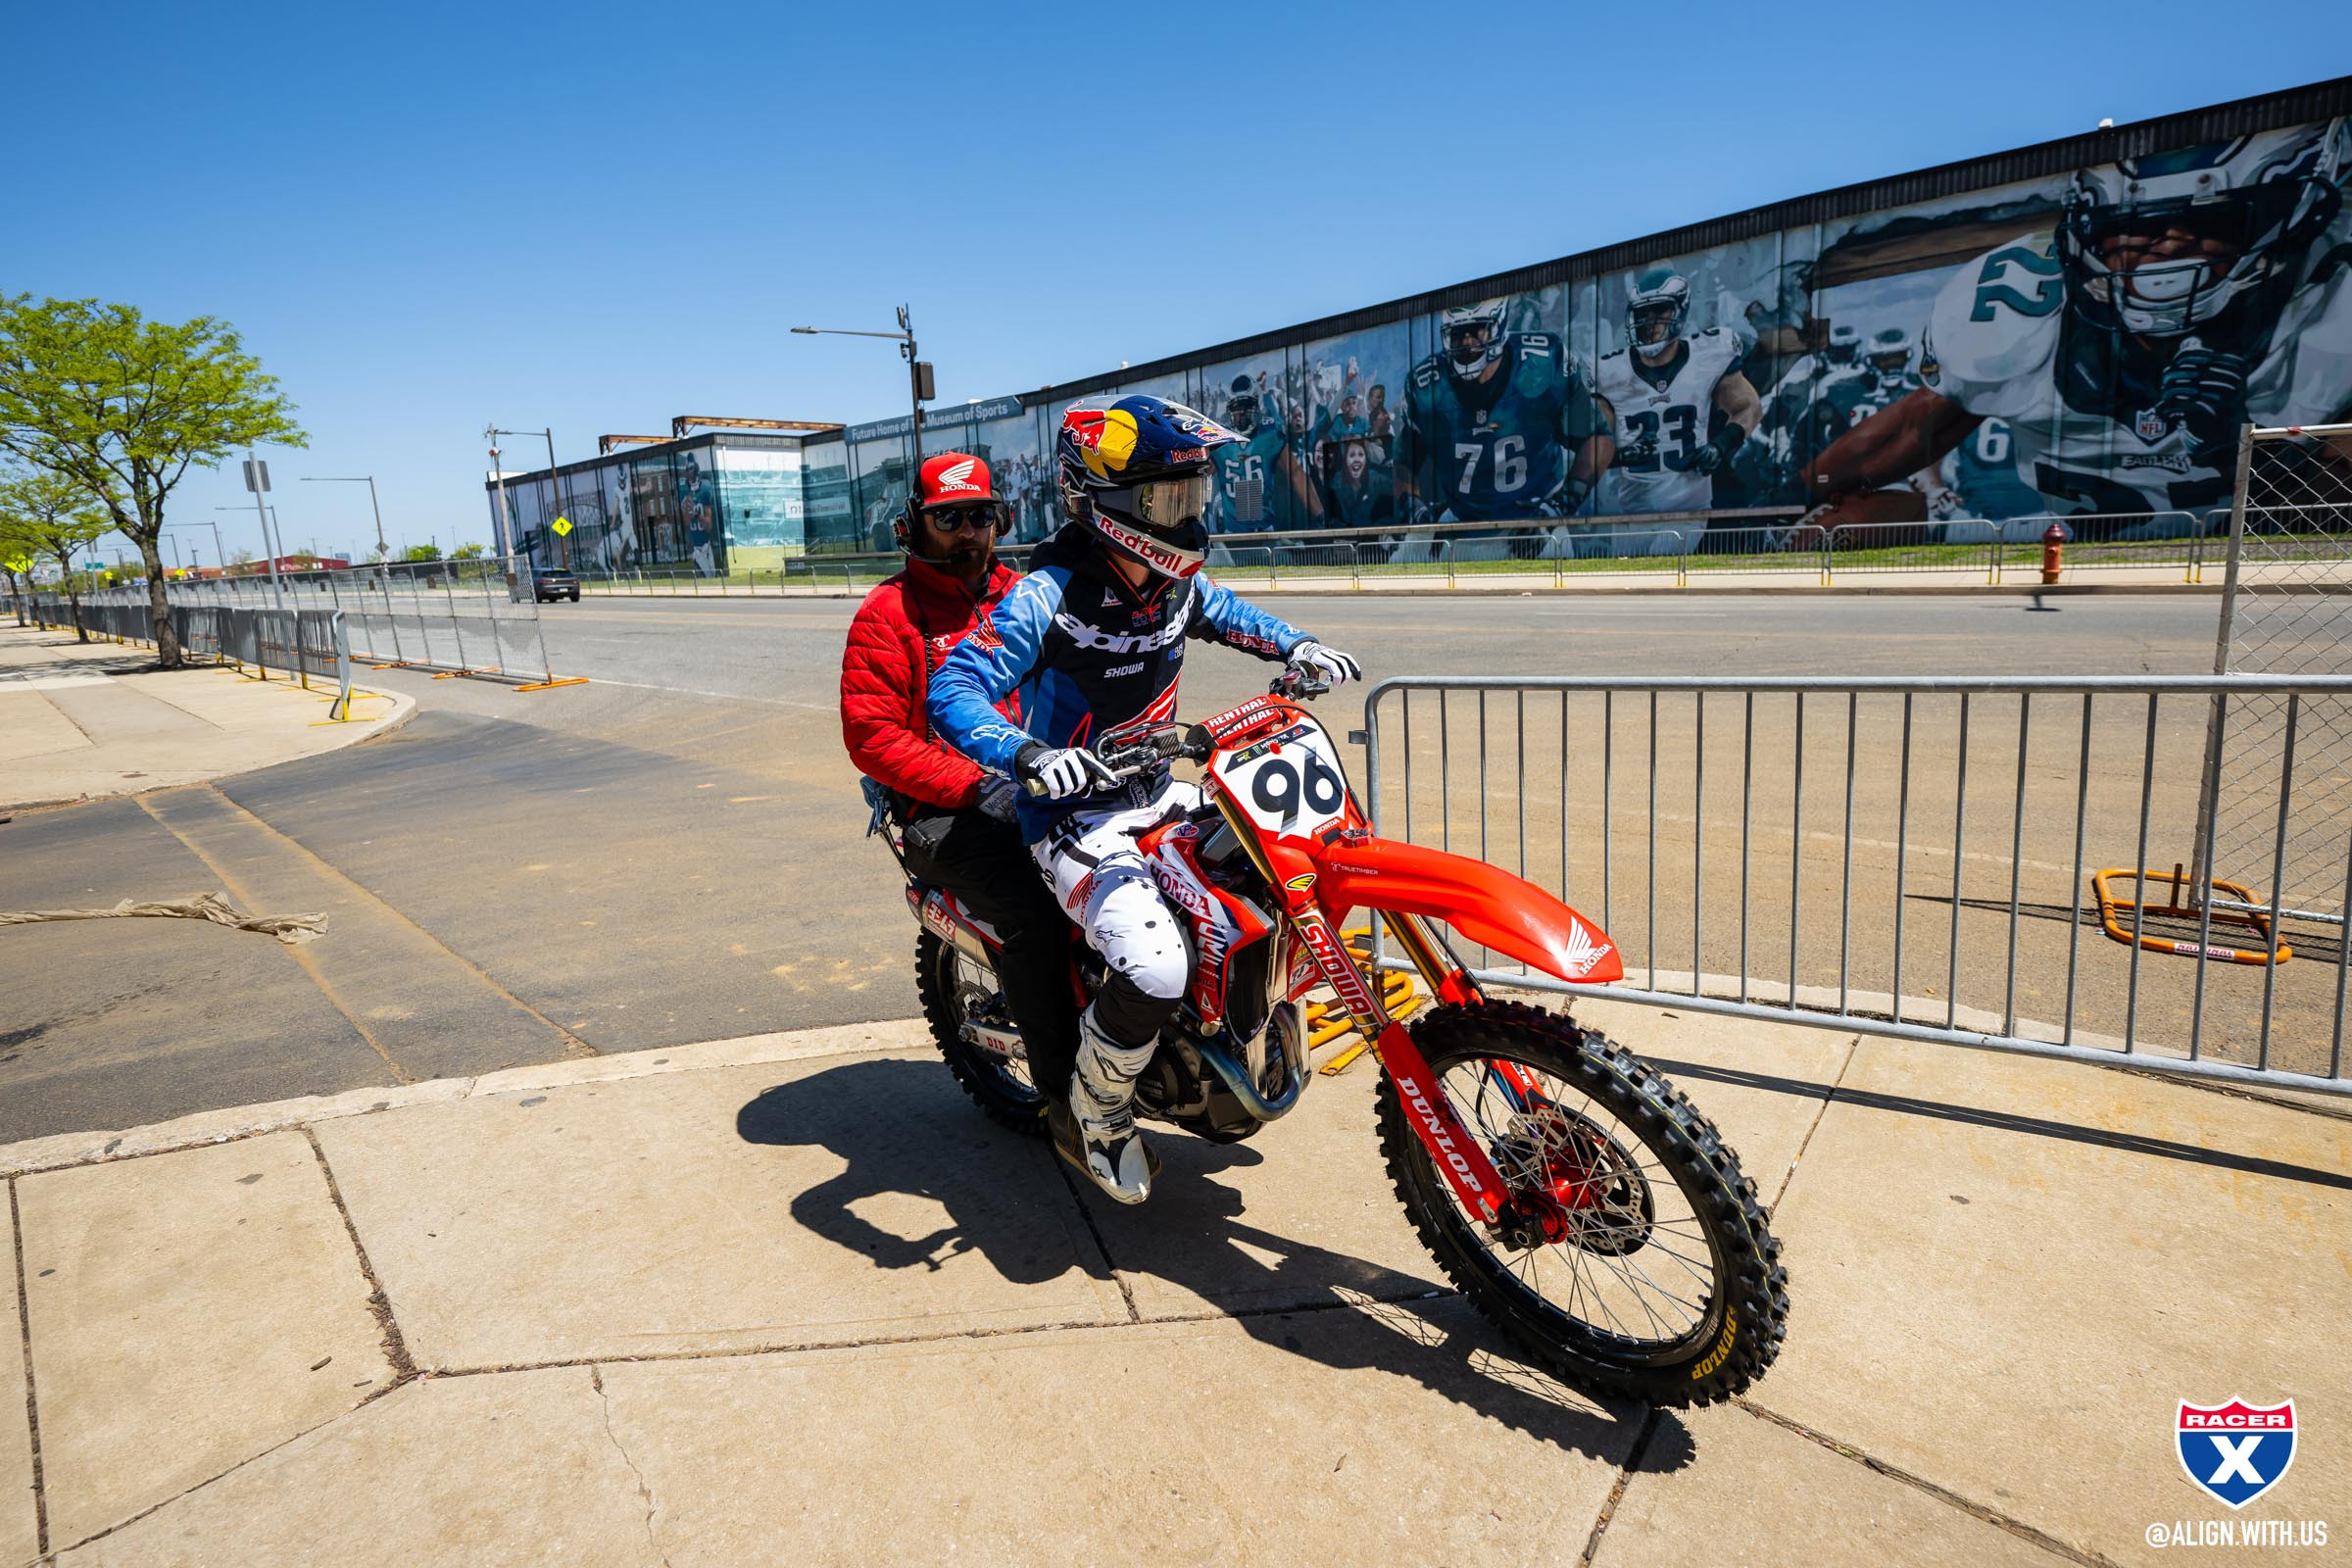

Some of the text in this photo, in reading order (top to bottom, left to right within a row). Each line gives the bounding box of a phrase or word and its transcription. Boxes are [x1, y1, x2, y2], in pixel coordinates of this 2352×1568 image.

[852, 427, 876, 441] Future
[876, 422, 900, 435] Home
[900, 419, 910, 432] of
[926, 413, 964, 426] Museum
[964, 408, 975, 421] of
[975, 403, 1008, 422] Sports
[2140, 422, 2163, 433] NFL
[1225, 454, 1264, 499] 56
[1454, 434, 1528, 494] 76
[939, 483, 982, 494] HONDA
[1099, 516, 1142, 550] Red
[965, 632, 995, 660] ONDA
[1226, 629, 1279, 656] HONDA
[1103, 662, 1145, 678] SHOWA
[1208, 696, 1268, 728] RENTHAL
[1251, 746, 1344, 834] 96
[1313, 817, 1341, 835] HONDA
[1150, 863, 1213, 918] HONDA
[1299, 922, 1373, 1016] SHOWA
[1578, 943, 1613, 976] HONDA
[1396, 1076, 1483, 1193] DUNLOP
[1691, 1312, 1737, 1380] DUNLOP
